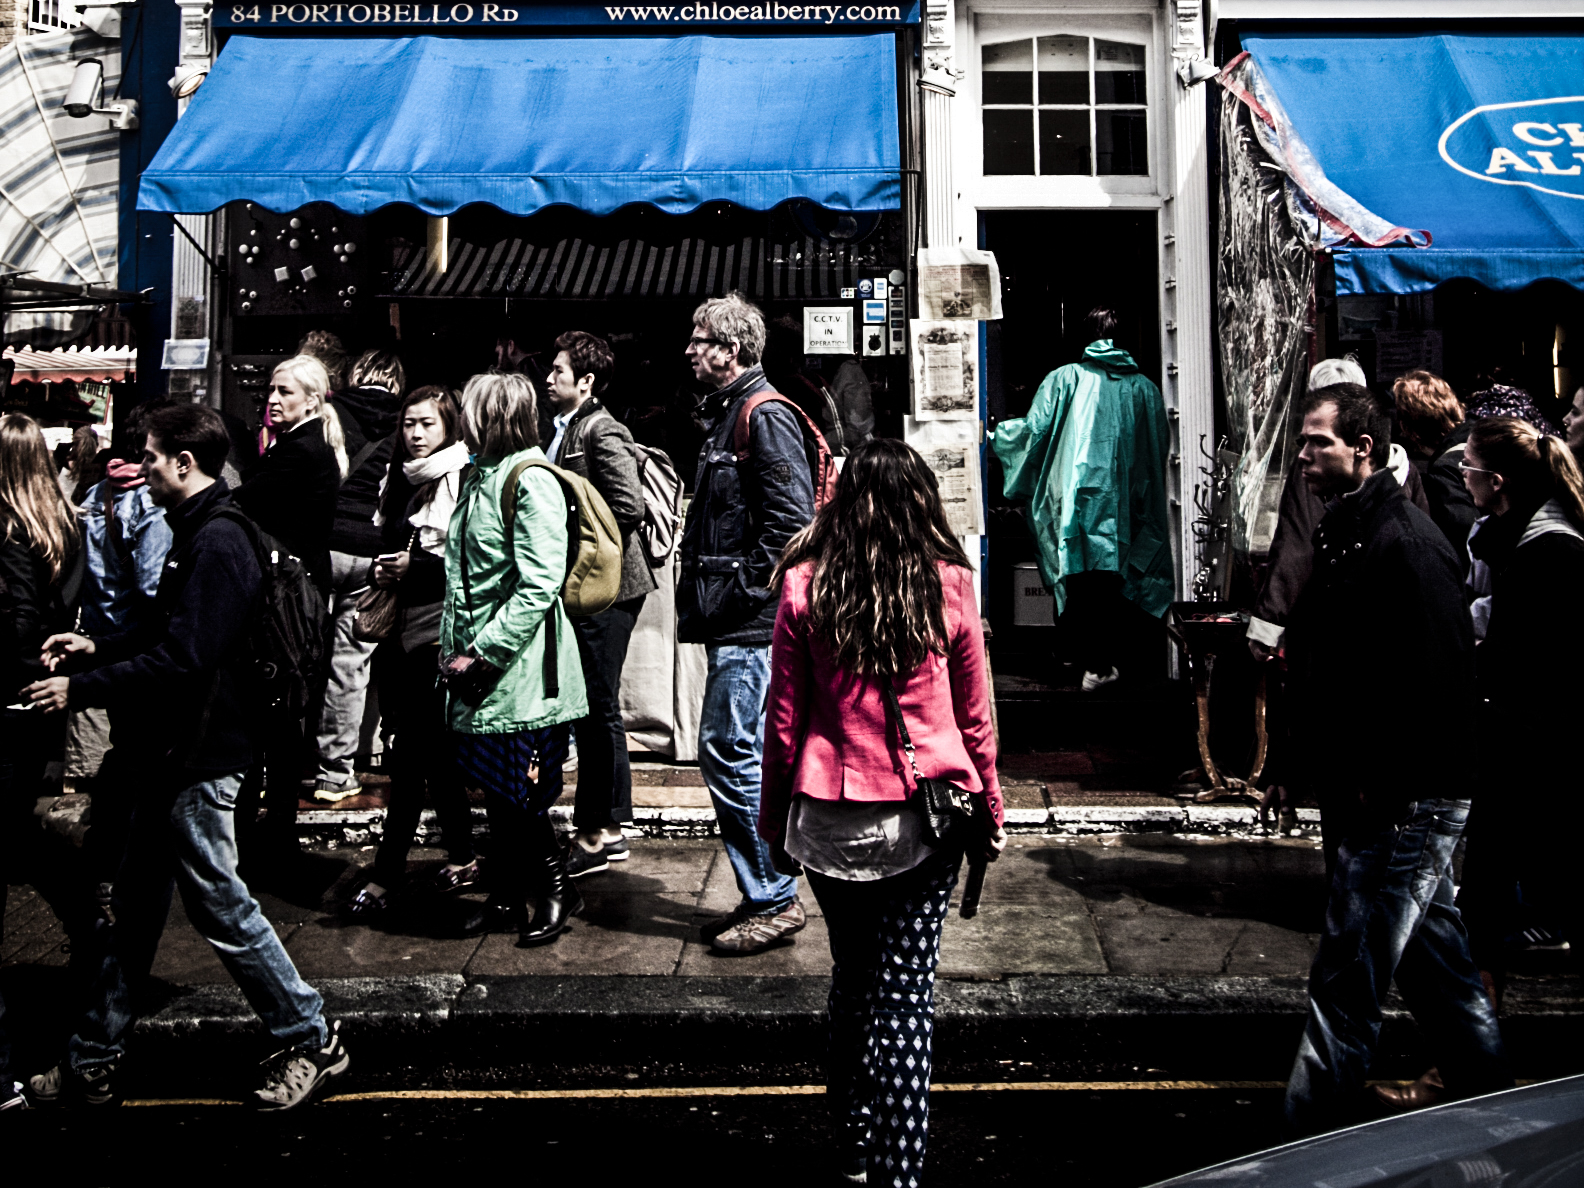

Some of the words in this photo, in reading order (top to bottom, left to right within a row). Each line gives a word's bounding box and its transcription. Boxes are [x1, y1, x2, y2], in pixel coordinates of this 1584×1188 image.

[230, 4, 261, 24] 84
[270, 3, 474, 24] PORTOBELLO
[604, 1, 902, 25] www.chloealberry.com
[1484, 147, 1584, 176] AL
